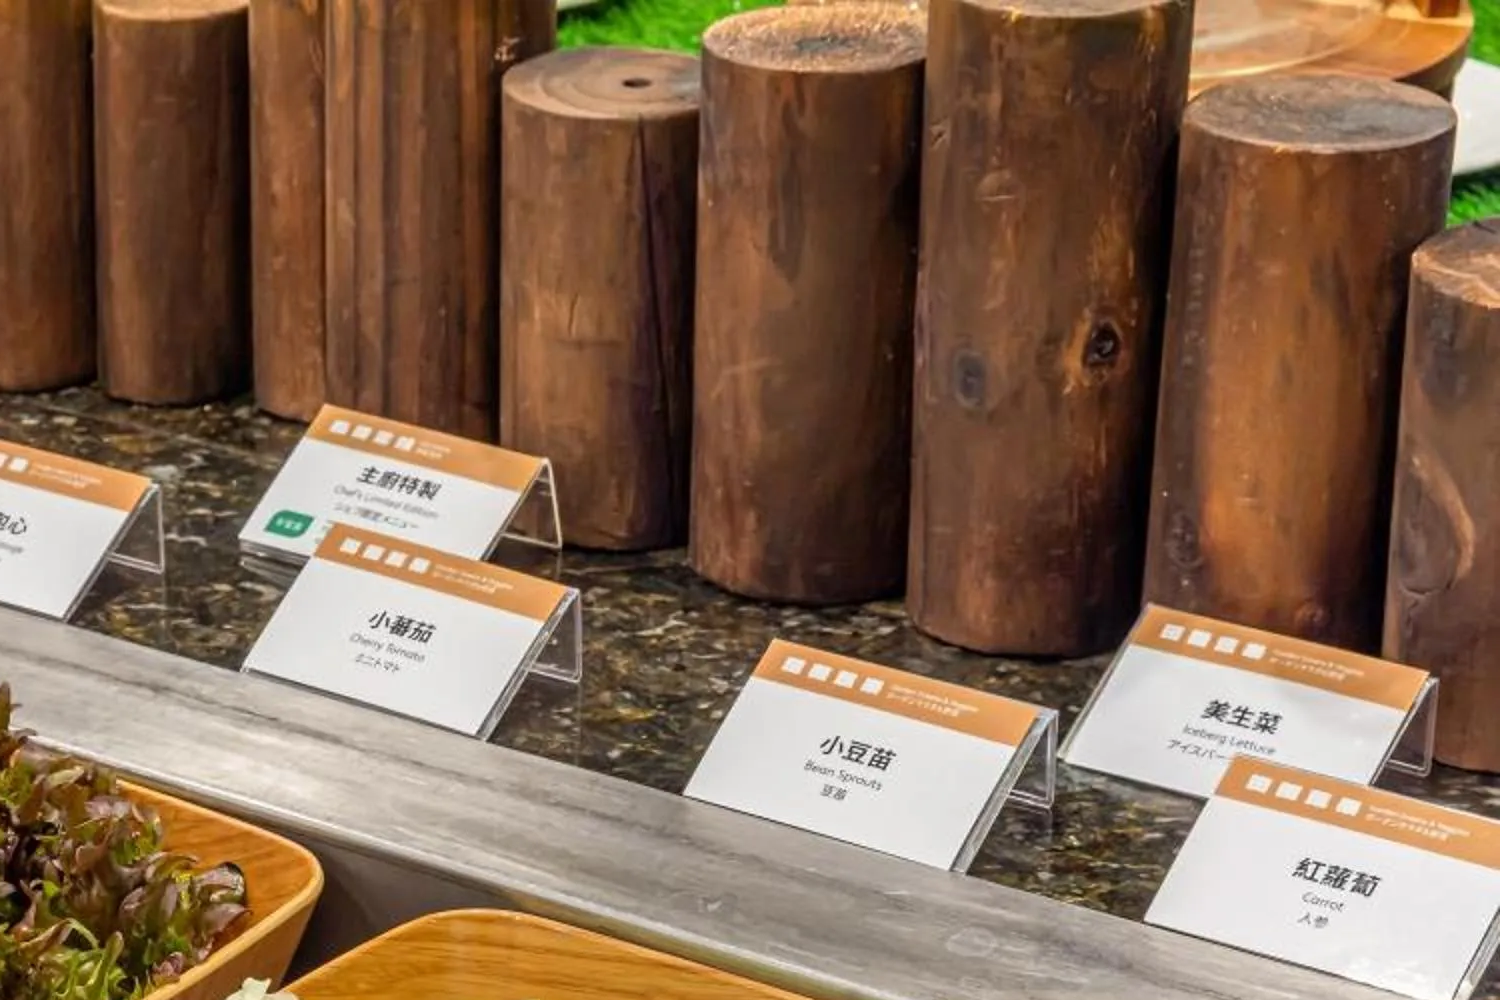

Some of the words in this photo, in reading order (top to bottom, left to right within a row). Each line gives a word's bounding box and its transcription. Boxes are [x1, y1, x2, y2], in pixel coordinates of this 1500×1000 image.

[356, 466, 442, 500] 主廚特製
[349, 632, 384, 652] Cherry
[385, 643, 426, 662] Tomato
[1200, 699, 1283, 735] 美生菜
[819, 735, 897, 771] 小豆苗
[1182, 723, 1227, 745] Iceberg
[1228, 735, 1277, 755] Lettuce
[803, 759, 835, 777] Bean
[837, 769, 882, 792] Sprouts
[1292, 857, 1382, 897] 紅蘿蔔
[1302, 891, 1345, 913] Carrot
